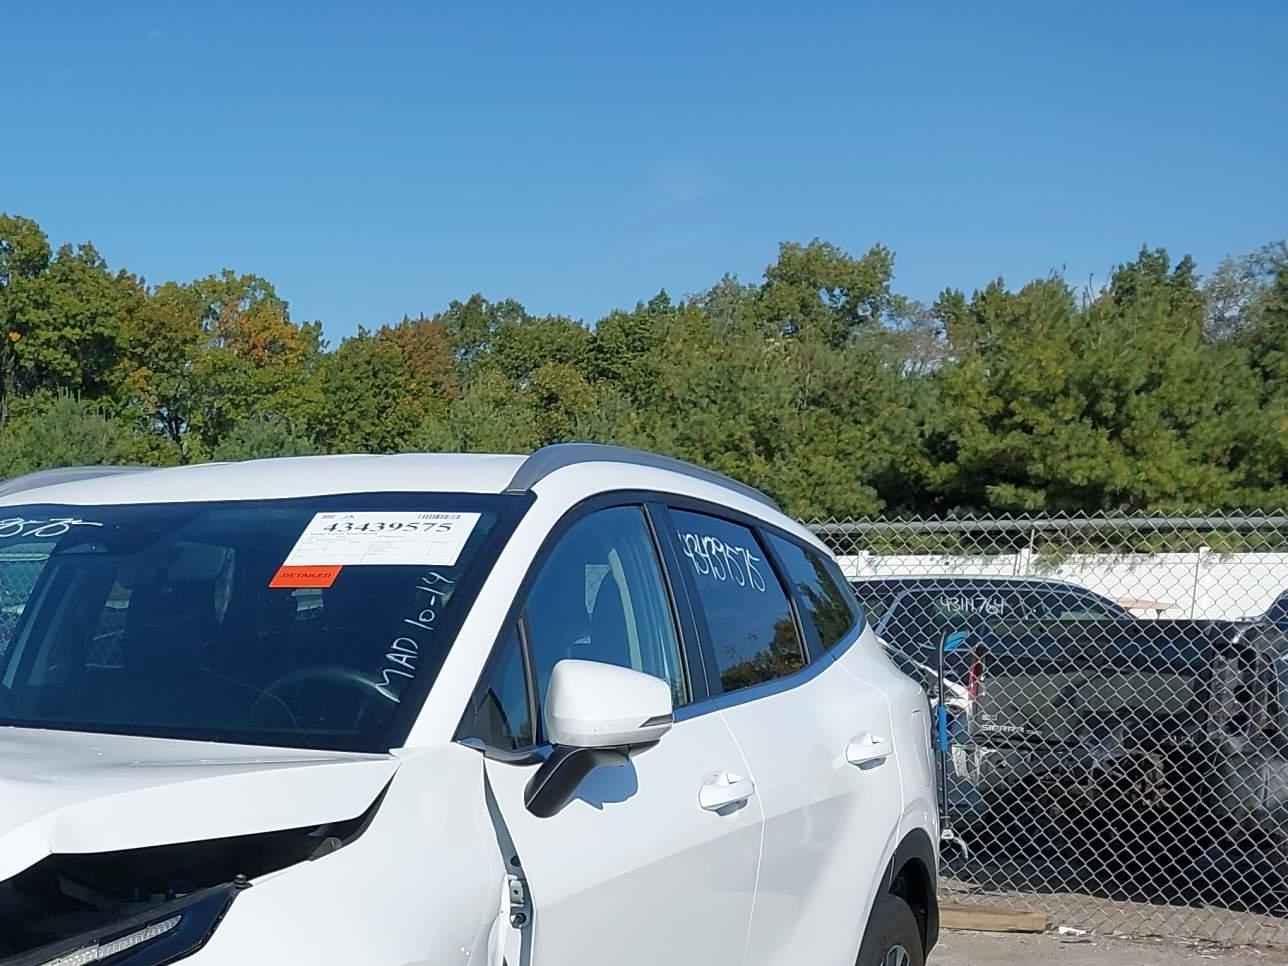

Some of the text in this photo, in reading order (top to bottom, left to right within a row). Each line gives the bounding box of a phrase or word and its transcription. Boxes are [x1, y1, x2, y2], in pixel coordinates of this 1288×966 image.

[322, 522, 454, 533] 43439575
[280, 571, 333, 579] DETAILED
[375, 571, 455, 703] MAD 10-14
